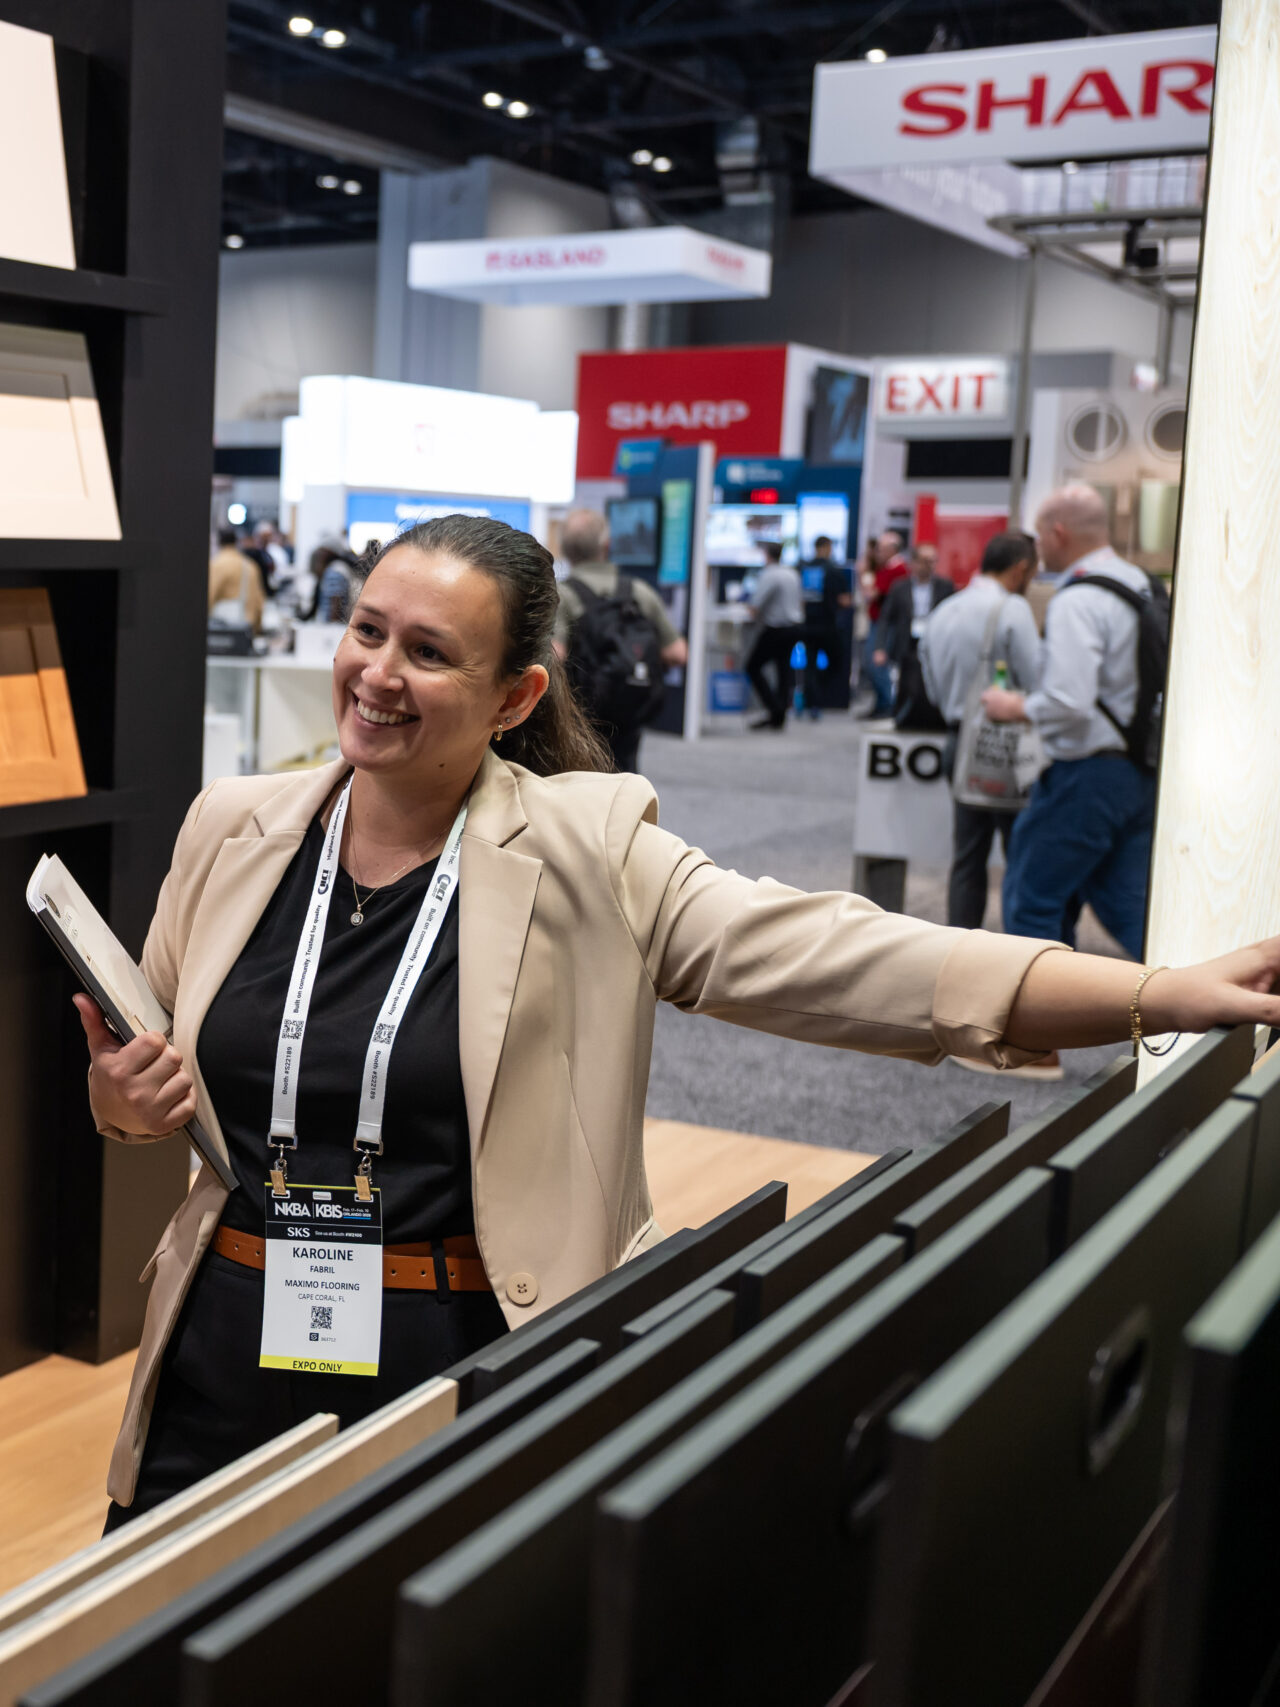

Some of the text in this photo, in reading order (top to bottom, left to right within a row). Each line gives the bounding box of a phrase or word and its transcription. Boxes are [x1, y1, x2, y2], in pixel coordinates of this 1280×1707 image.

[885, 374, 995, 411] EXIT
[607, 399, 749, 429] SHARP
[426, 908, 436, 922] Built
[422, 922, 430, 930] on
[292, 1000, 300, 1014] Built
[296, 990, 302, 998] on
[306, 934, 316, 956] Trusted
[400, 964, 414, 986] Trusted
[396, 986, 404, 996] for
[372, 1050, 382, 1070] Booth
[274, 1202, 343, 1218] NKBA KBIS
[287, 1227, 310, 1238] SKS
[292, 1247, 354, 1261] KAROLINE
[310, 1265, 335, 1274] FABRIL
[284, 1279, 360, 1291] MAXIMO FLOORING
[292, 1360, 342, 1372] EXPO ONLY
